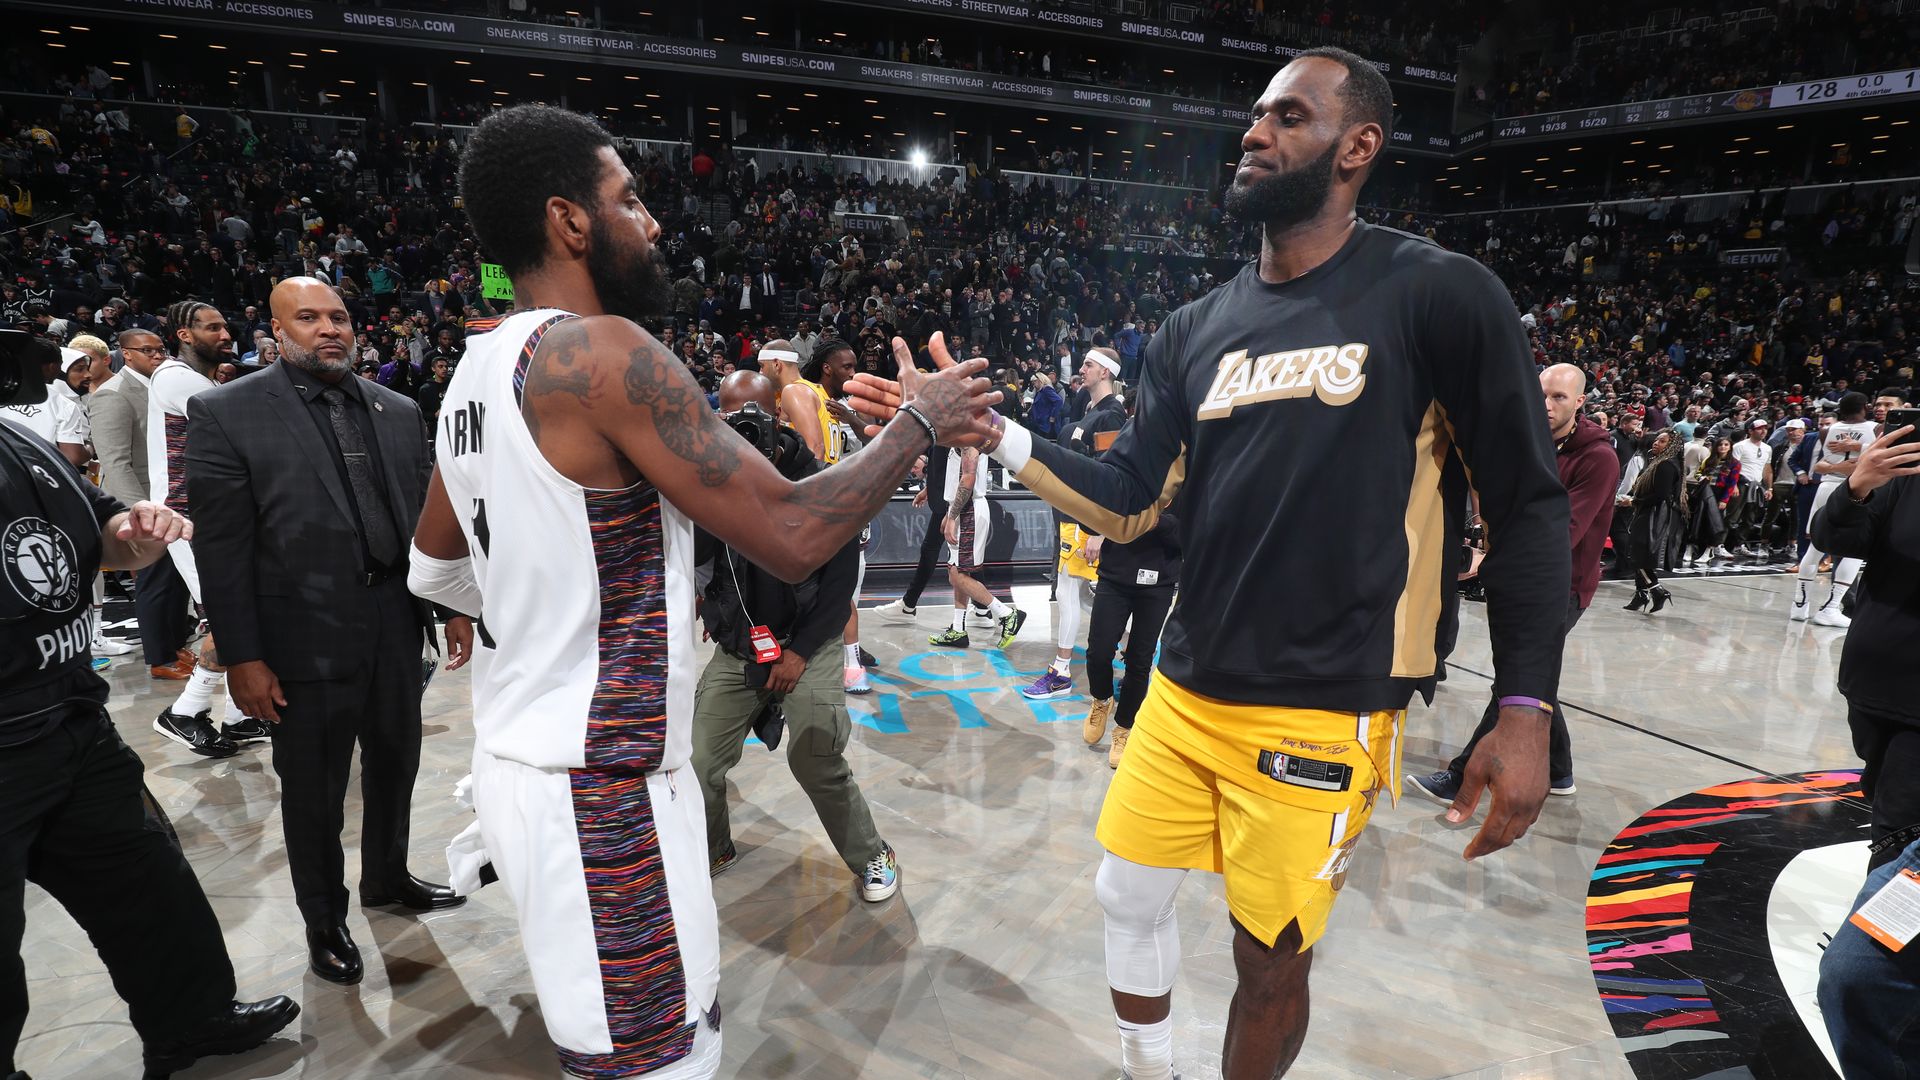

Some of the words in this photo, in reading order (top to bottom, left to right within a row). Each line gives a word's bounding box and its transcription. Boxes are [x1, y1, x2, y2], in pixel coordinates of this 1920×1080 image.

[225, 2, 314, 20] ACCESSORIES
[962, 1, 1029, 18] STREETWEAR
[1037, 10, 1103, 28] ACCESSORIES
[343, 12, 456, 33] SNIPESUSA.COM
[1121, 22, 1205, 44] SNIPESUSA.COM
[486, 26, 549, 42] SNEAKERS
[559, 34, 634, 50] STREETWEAR
[643, 43, 717, 59] ACCESSORIES
[1221, 38, 1268, 52] SNEAKERS
[741, 52, 835, 72] SNIPESUSA.COM
[861, 66, 913, 80] SNEAKERS
[921, 73, 984, 88] STREETWEAR
[992, 82, 1053, 96] ACCESSORIES
[1857, 75, 1884, 88] 0.0
[1073, 90, 1151, 108] SNIPESUSA.COM
[1795, 82, 1838, 101] 128
[1860, 87, 1893, 96] Quarter
[1172, 103, 1216, 116] SNEAKERS
[1627, 113, 1640, 122] 52
[1656, 110, 1670, 119] 28
[1500, 127, 1526, 136] 47/94
[1541, 122, 1567, 132] 19/38
[1580, 118, 1607, 128] 15/20
[1197, 343, 1369, 422] LAKERS
